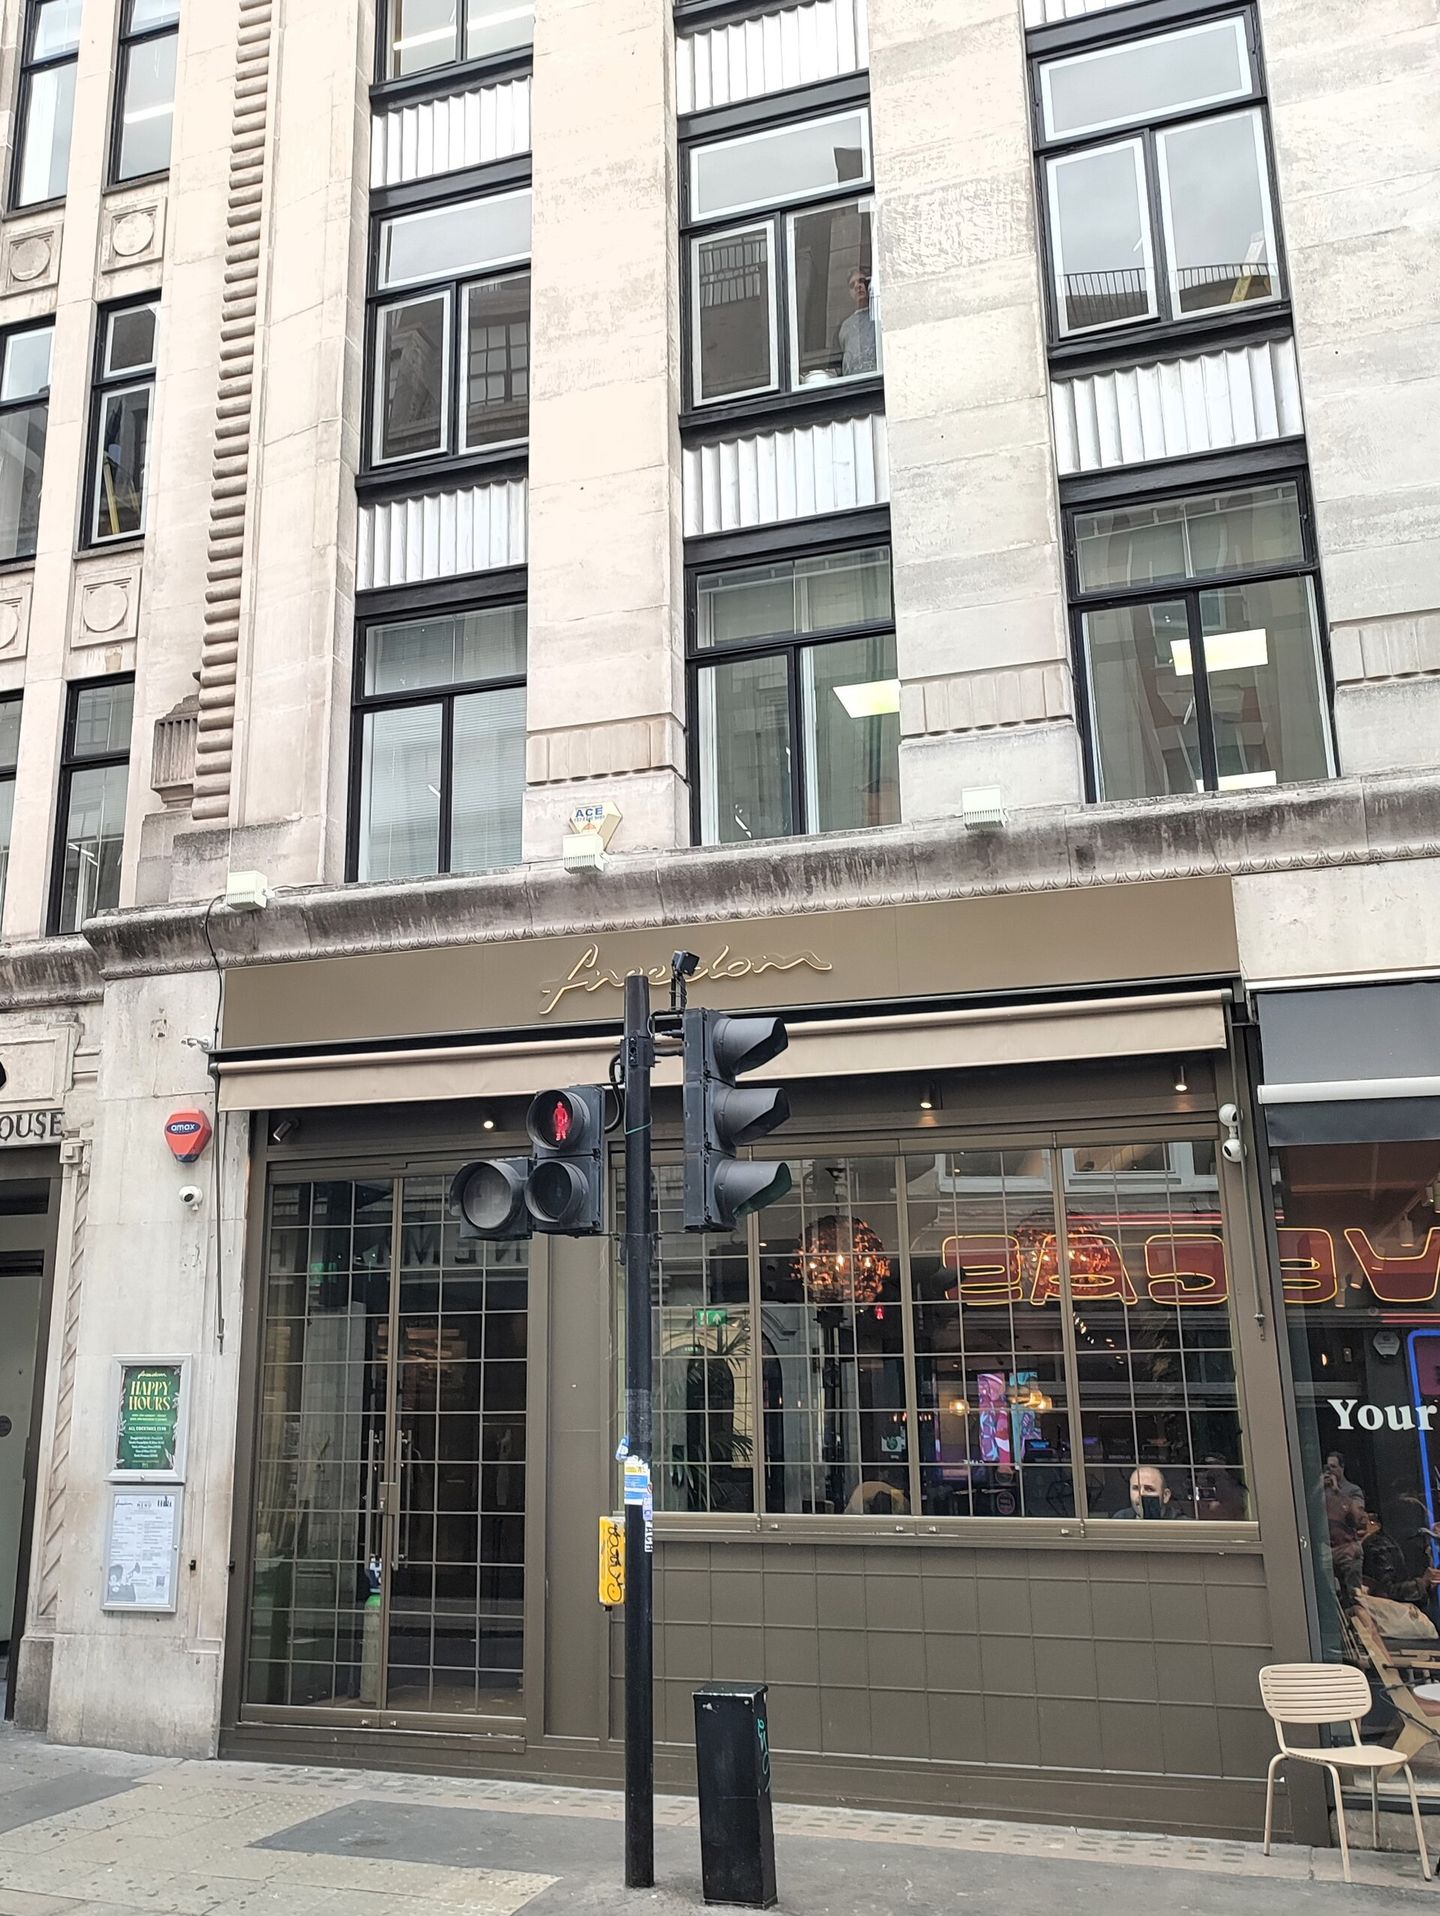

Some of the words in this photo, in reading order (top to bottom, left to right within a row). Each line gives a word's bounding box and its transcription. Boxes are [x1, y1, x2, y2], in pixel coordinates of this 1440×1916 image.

[575, 806, 603, 818] ACE
[538, 943, 833, 1015] freedom
[170, 1123, 196, 1132] amax
[131, 1381, 171, 1395] HAPPY
[128, 1396, 171, 1411] HOURS
[1327, 1398, 1438, 1431] Your
